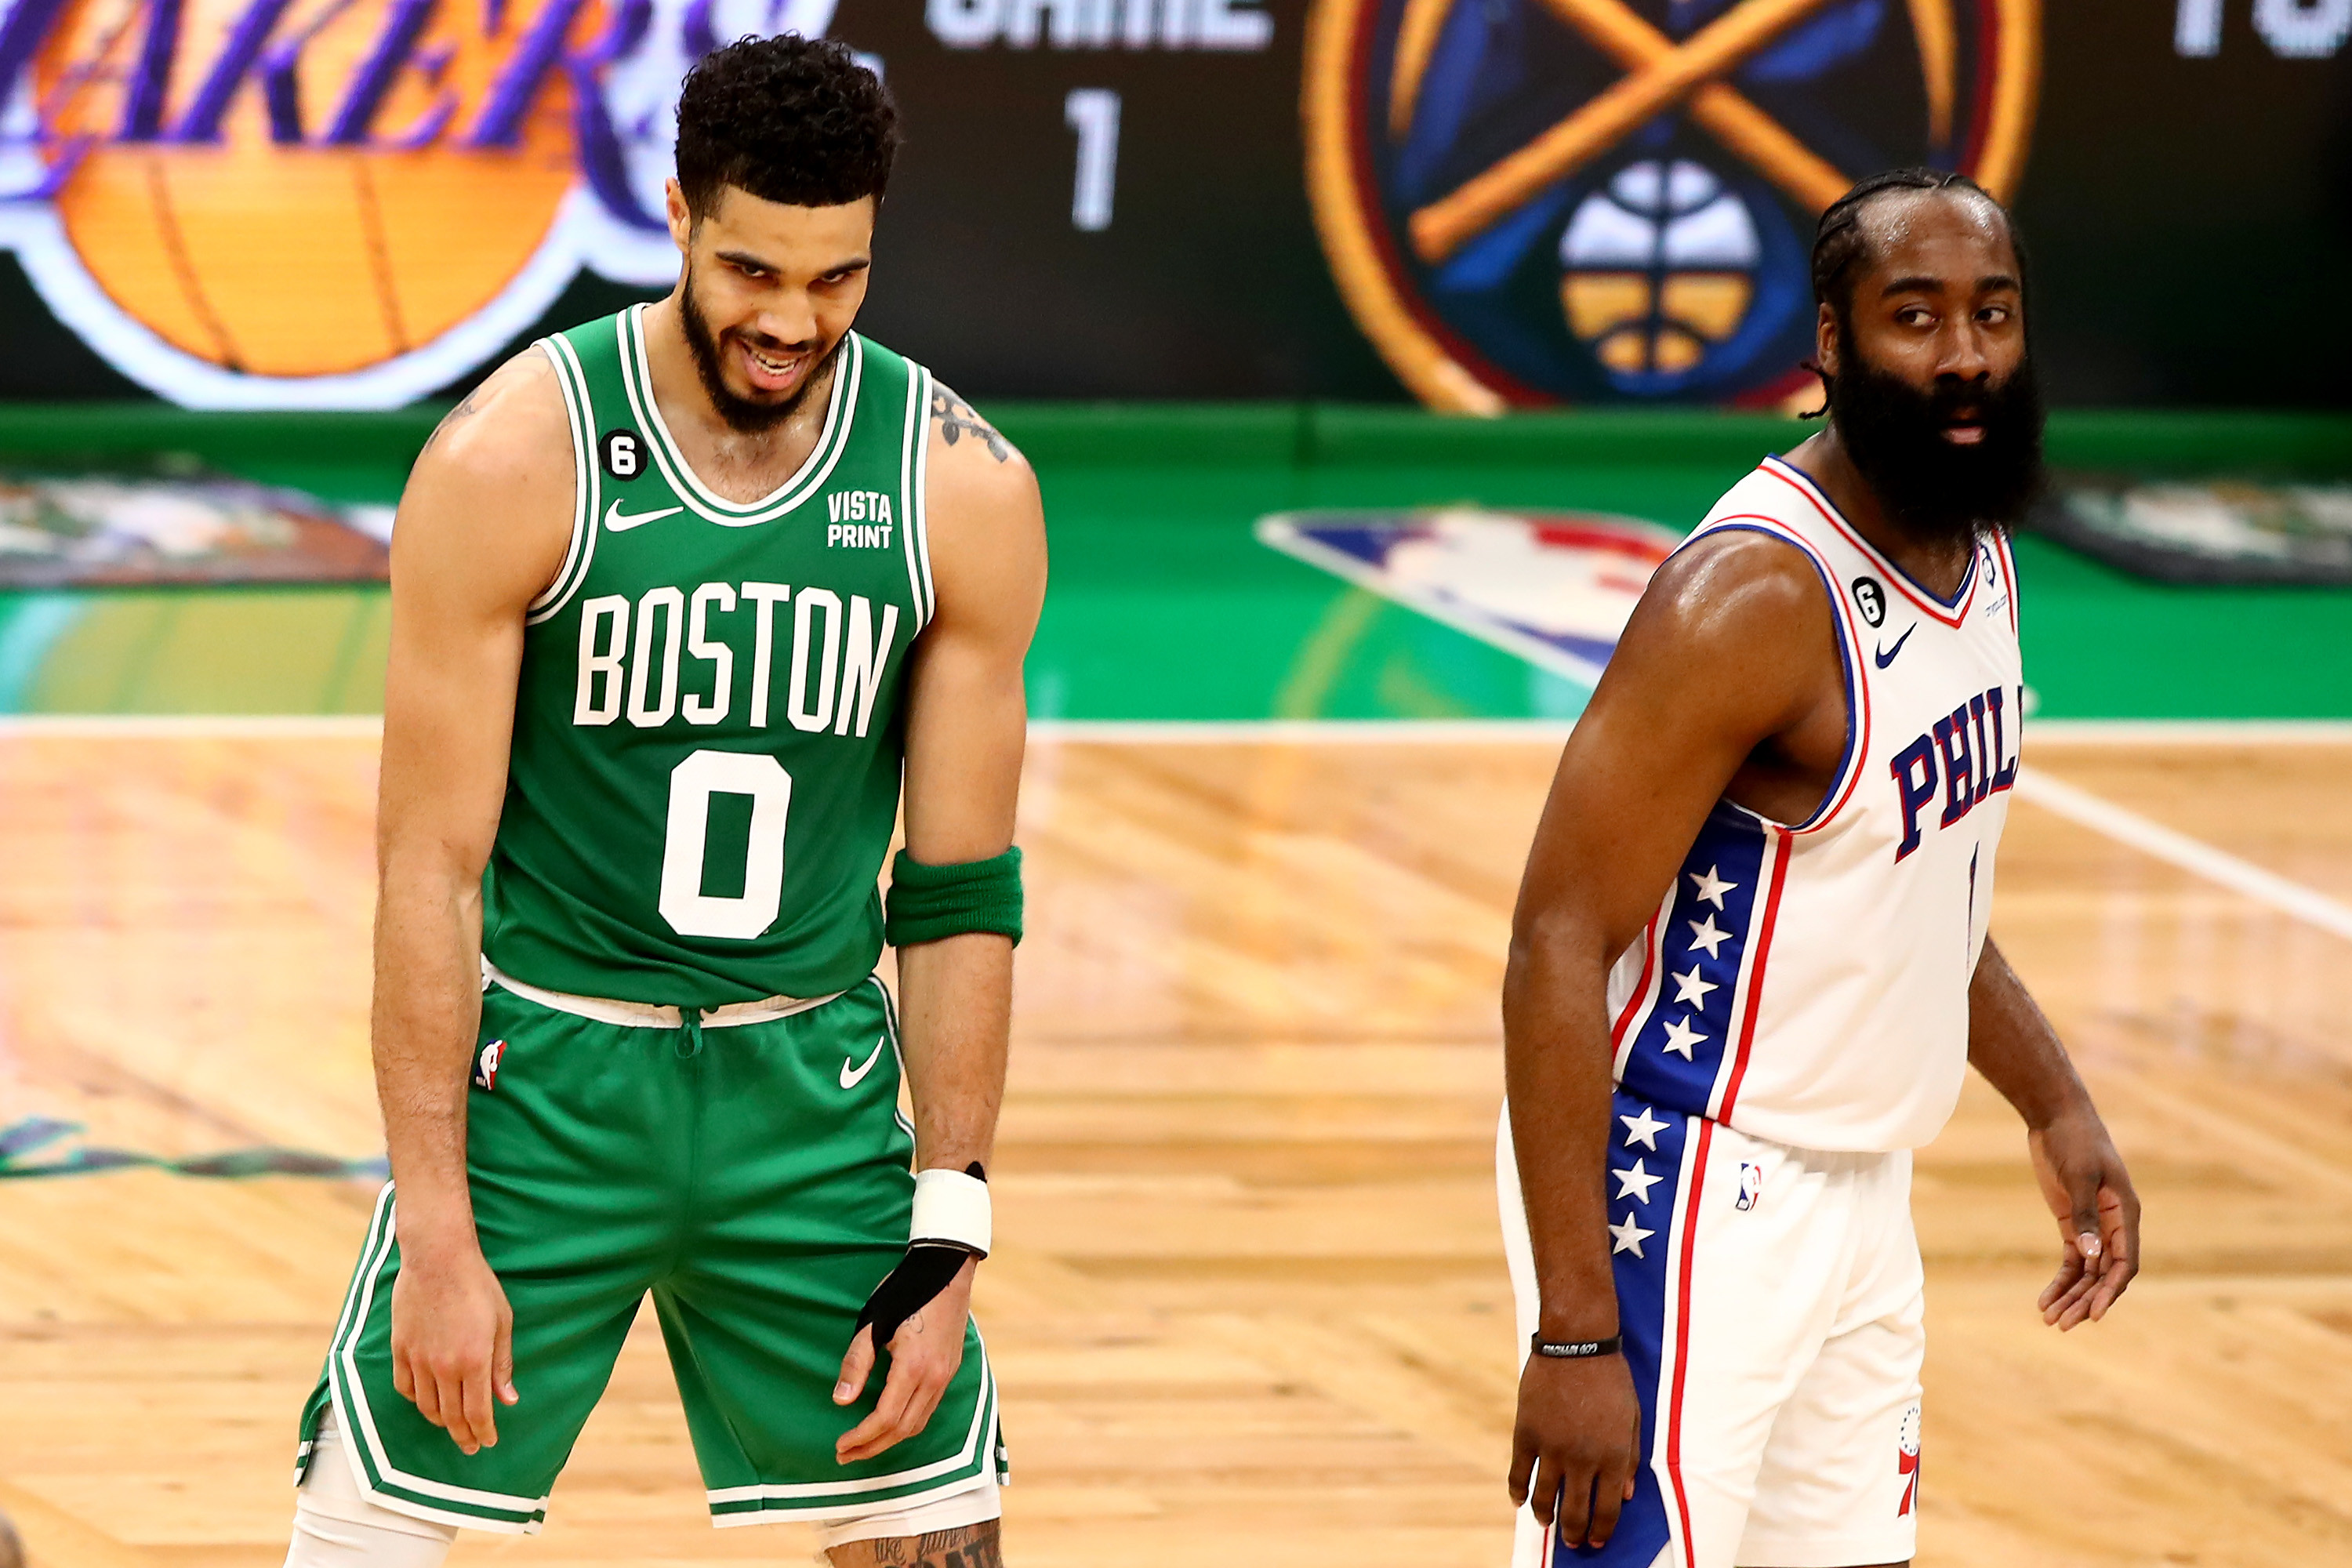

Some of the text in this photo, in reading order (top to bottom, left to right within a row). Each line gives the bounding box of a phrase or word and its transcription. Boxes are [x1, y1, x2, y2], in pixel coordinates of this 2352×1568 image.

[1063, 87, 1123, 232] 1
[610, 436, 636, 475] 6
[827, 490, 893, 525] VISTA
[827, 524, 893, 549] PRINT
[1856, 585, 1880, 626] 6
[572, 582, 899, 737] BOSTON
[1890, 684, 2024, 866] PHIL
[658, 749, 793, 940] 0
